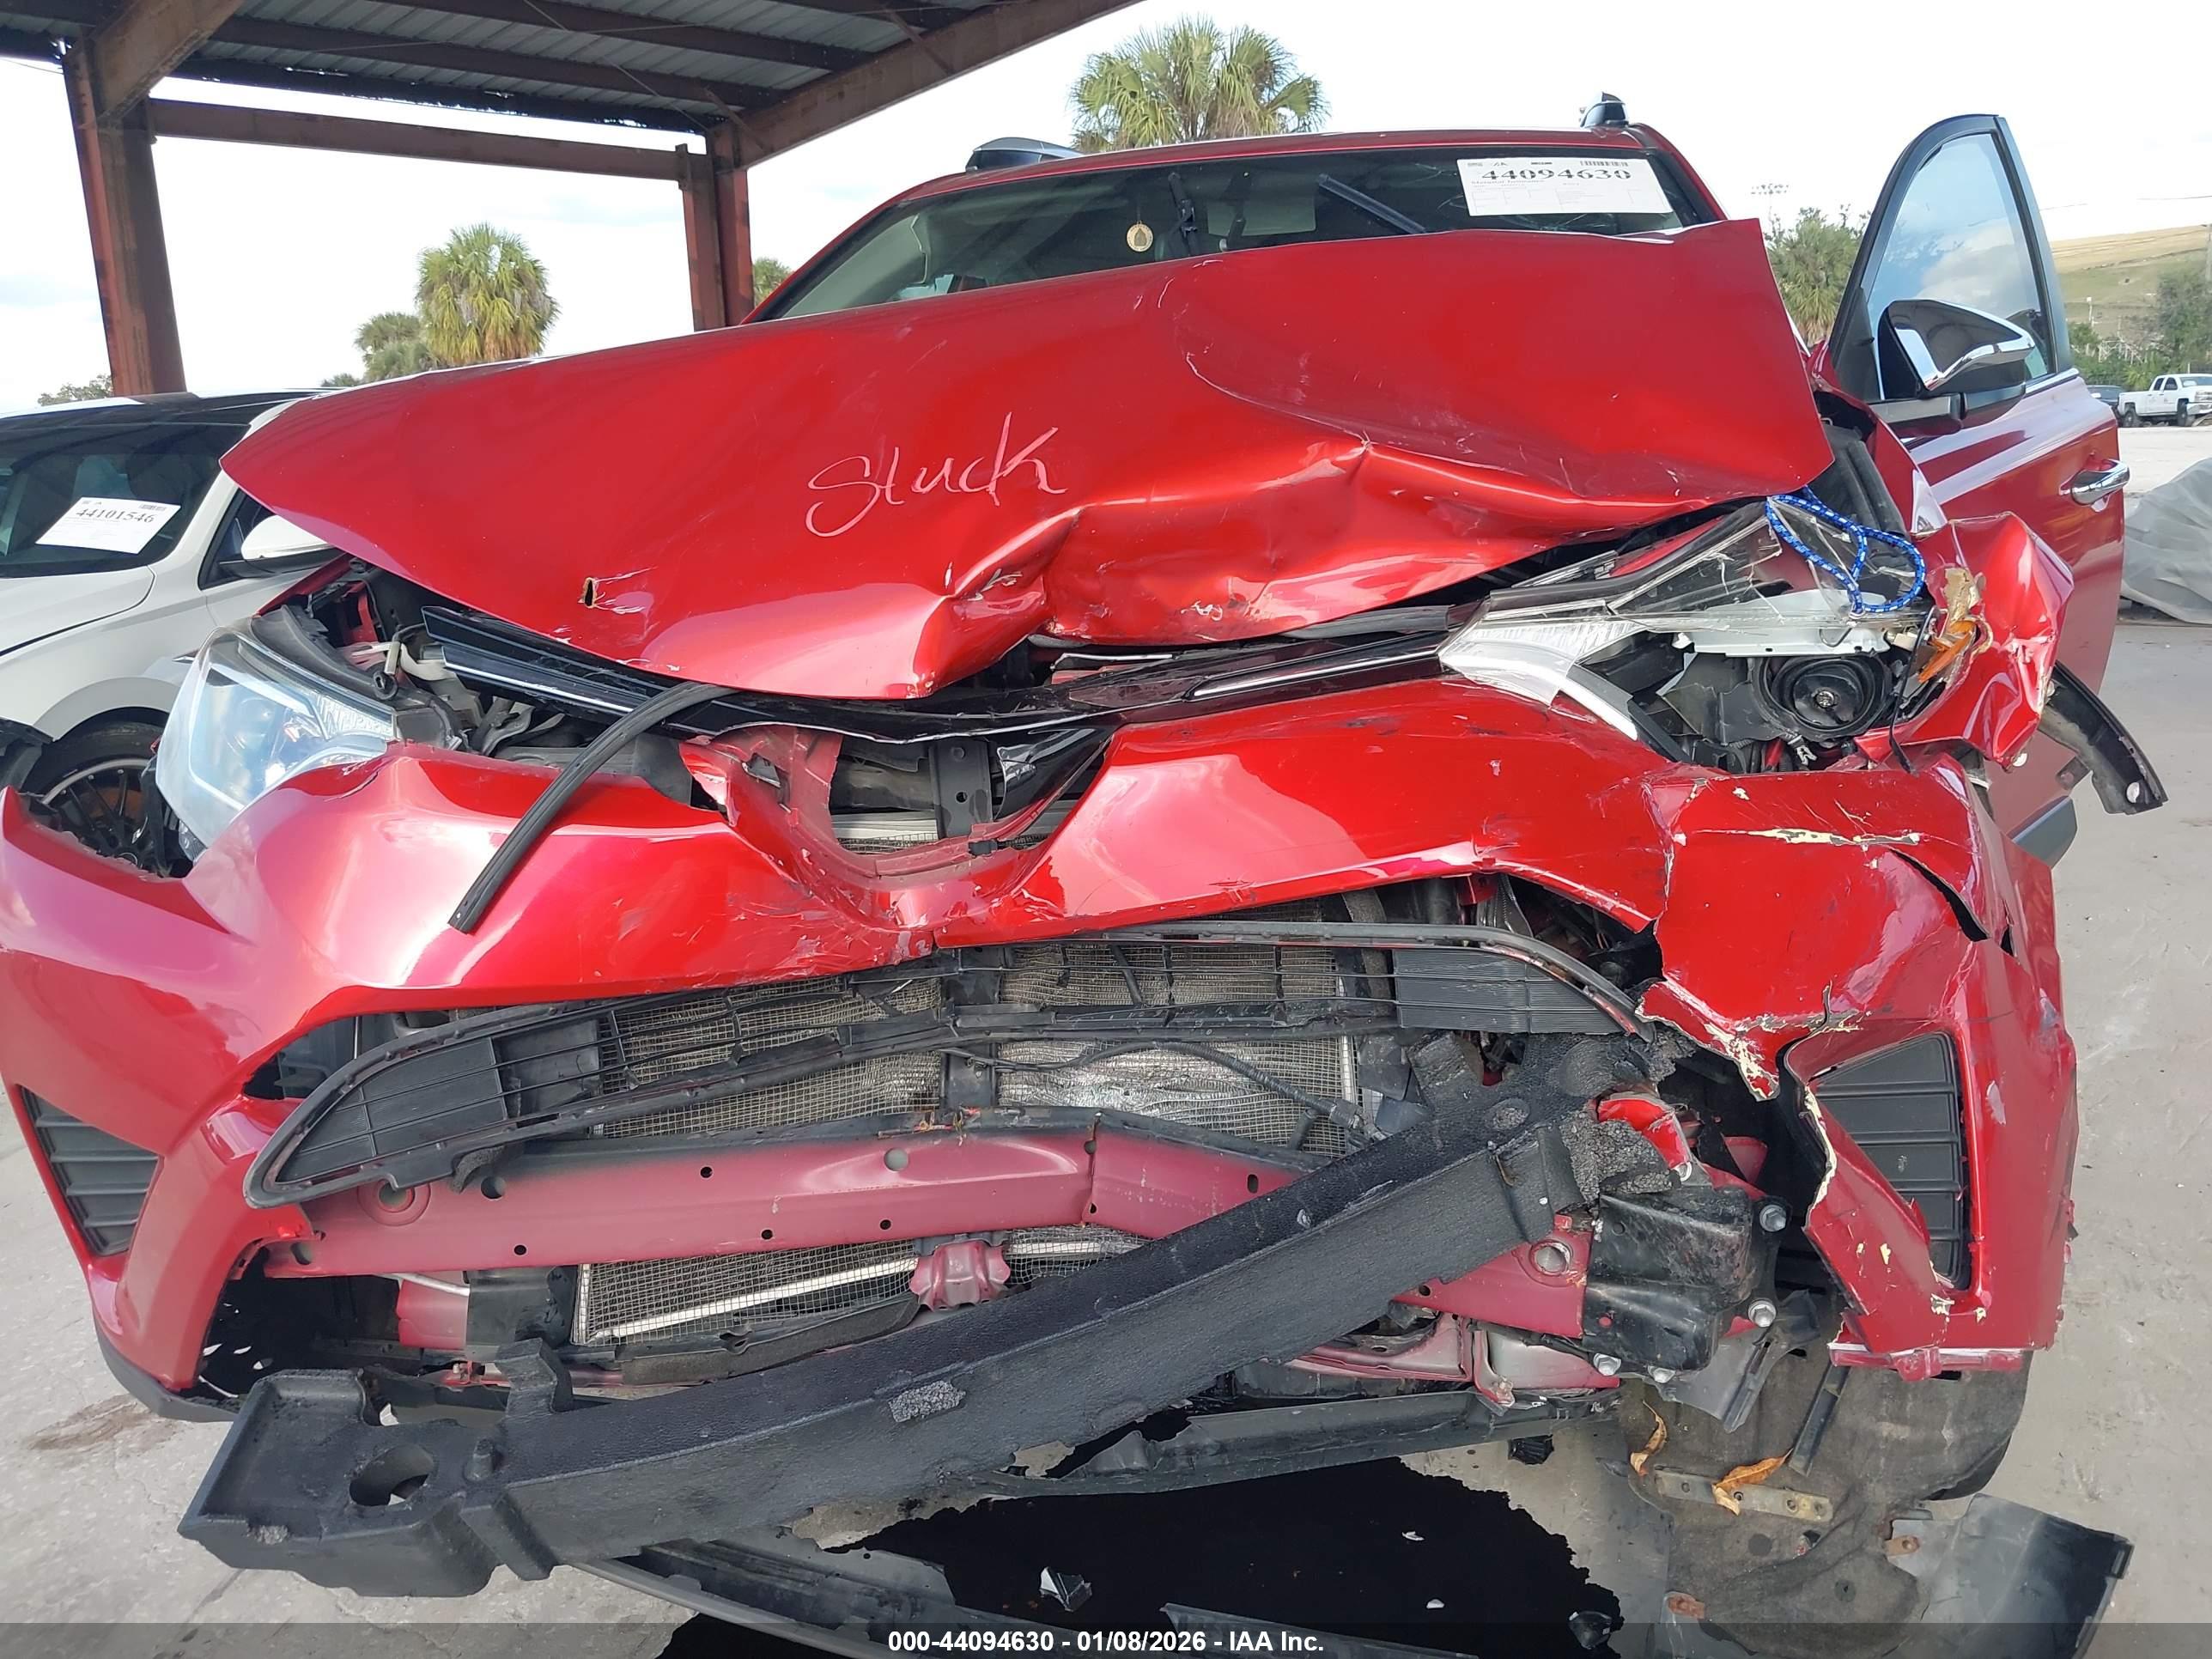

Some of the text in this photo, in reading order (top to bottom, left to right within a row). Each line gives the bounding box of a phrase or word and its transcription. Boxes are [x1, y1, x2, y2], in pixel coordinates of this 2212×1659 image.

[1481, 168, 1632, 180] 44094630
[805, 411, 1068, 538] Stuck
[76, 508, 156, 523] 44101546
